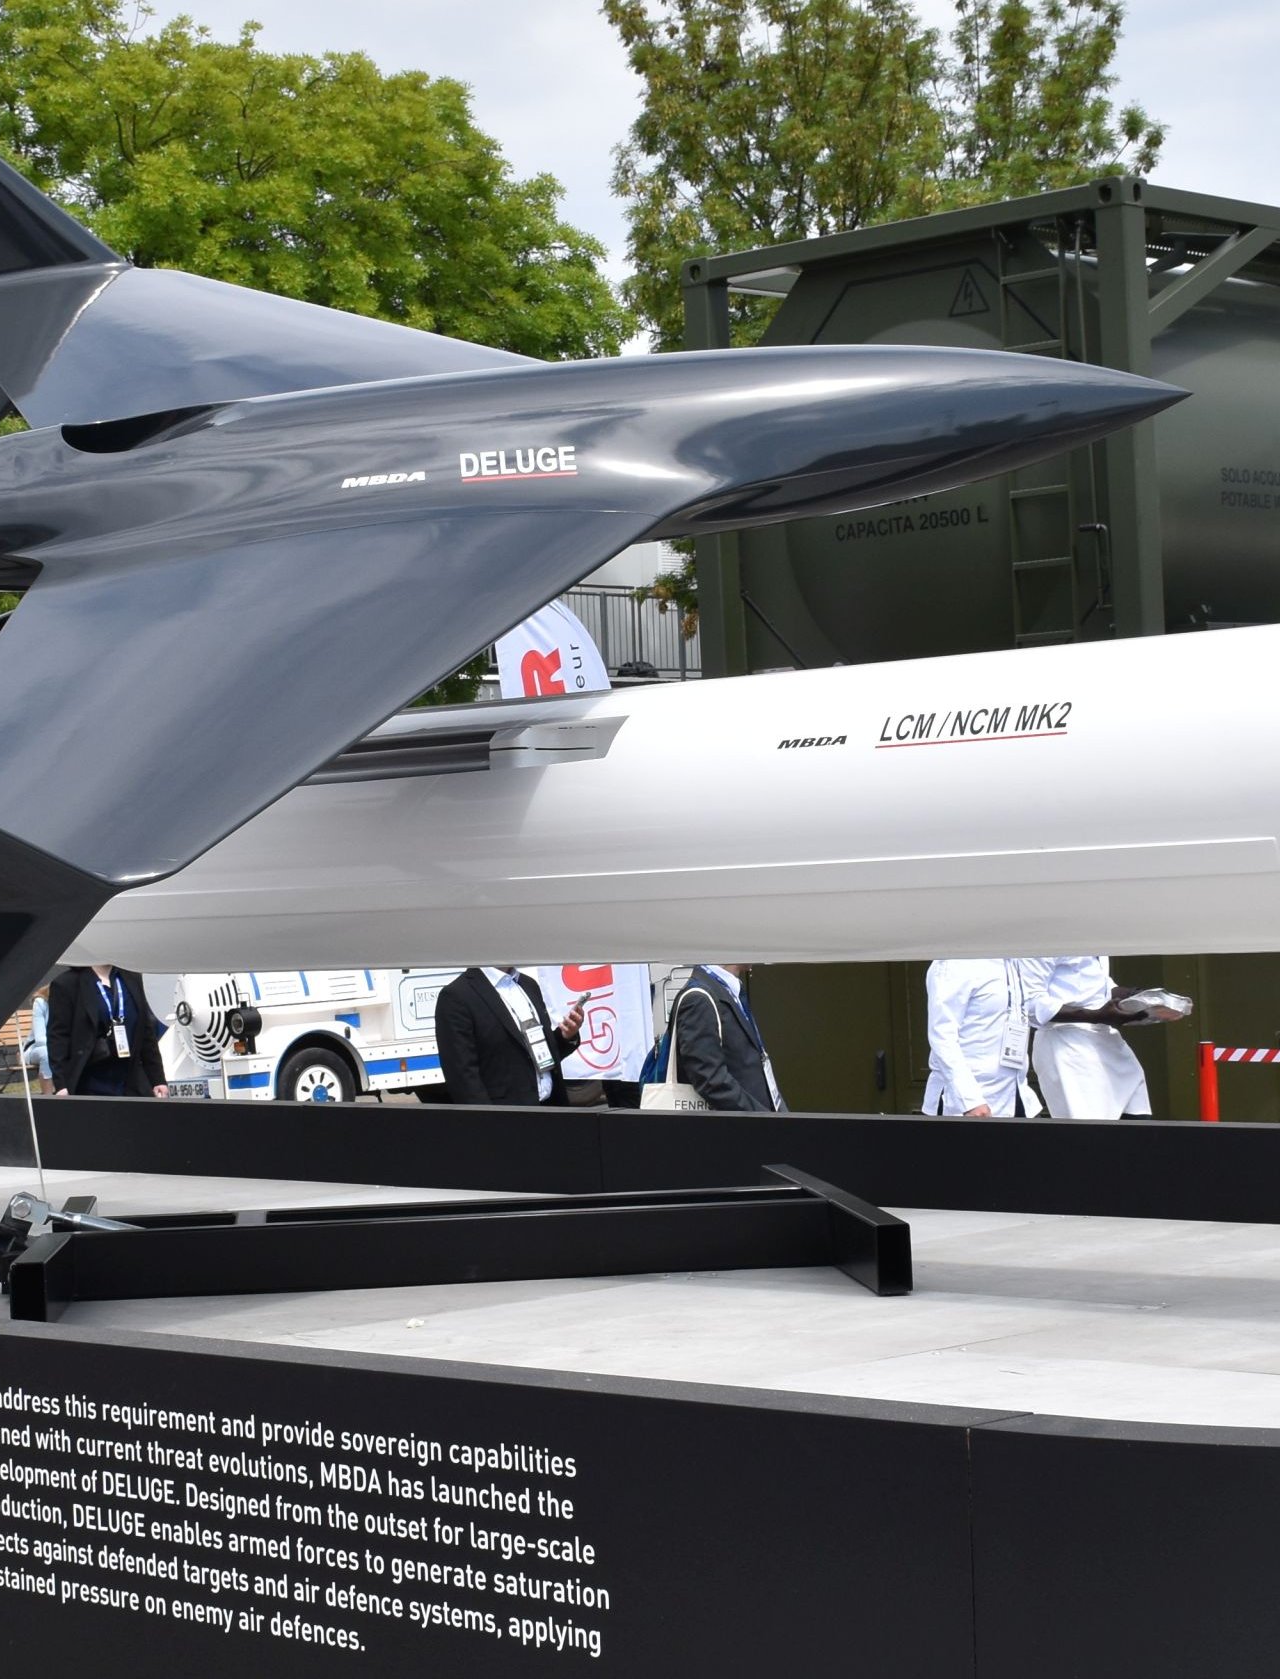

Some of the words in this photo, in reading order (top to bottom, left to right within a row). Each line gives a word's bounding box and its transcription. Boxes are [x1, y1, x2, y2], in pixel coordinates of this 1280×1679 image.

[341, 471, 426, 488] MBDA
[459, 445, 577, 478] DELUGE
[1220, 467, 1250, 484] SOLO
[1220, 491, 1272, 509] POTABLE
[835, 515, 915, 542] CAPACITA
[919, 507, 970, 531] 20500
[977, 505, 989, 524] L
[777, 735, 848, 750] MBDA
[1015, 701, 1073, 732] MK2
[64, 1393, 97, 1420] this
[102, 1401, 216, 1434] requirement
[221, 1414, 256, 1439] and
[261, 1420, 335, 1449] provide
[340, 1431, 442, 1467] sovereign
[449, 1443, 577, 1478] capabilities
[34, 1427, 72, 1453] with
[76, 1437, 143, 1463] current
[146, 1440, 204, 1471] threat
[208, 1451, 314, 1490] evolutions,
[320, 1461, 383, 1495] MBDA
[388, 1470, 425, 1500] has
[431, 1475, 531, 1514] launched
[537, 1489, 574, 1520] the
[81, 1469, 98, 1493] of
[102, 1470, 180, 1506] DELUGE.
[185, 1482, 271, 1520] Designed
[275, 1495, 322, 1526] from
[326, 1503, 359, 1531] the
[364, 1512, 428, 1542] outset
[433, 1516, 465, 1546] for
[470, 1521, 596, 1565] large-scale
[72, 1503, 146, 1538] DELUGE
[150, 1519, 223, 1550] enables
[228, 1533, 291, 1560] armed
[296, 1536, 360, 1571] forces
[364, 1549, 385, 1575] to
[391, 1557, 487, 1591] generate
[493, 1572, 610, 1610] saturation
[33, 1538, 94, 1566] against
[97, 1544, 179, 1581] defended
[182, 1559, 249, 1594] targets
[253, 1573, 288, 1599] and
[293, 1577, 321, 1604] air
[325, 1581, 404, 1618] defence
[409, 1601, 502, 1639] systems,
[508, 1616, 602, 1658] applying
[61, 1580, 140, 1611] pressure
[144, 1595, 167, 1616] on
[171, 1599, 234, 1634] enemy
[238, 1606, 265, 1633] air
[270, 1611, 366, 1652] defences.
